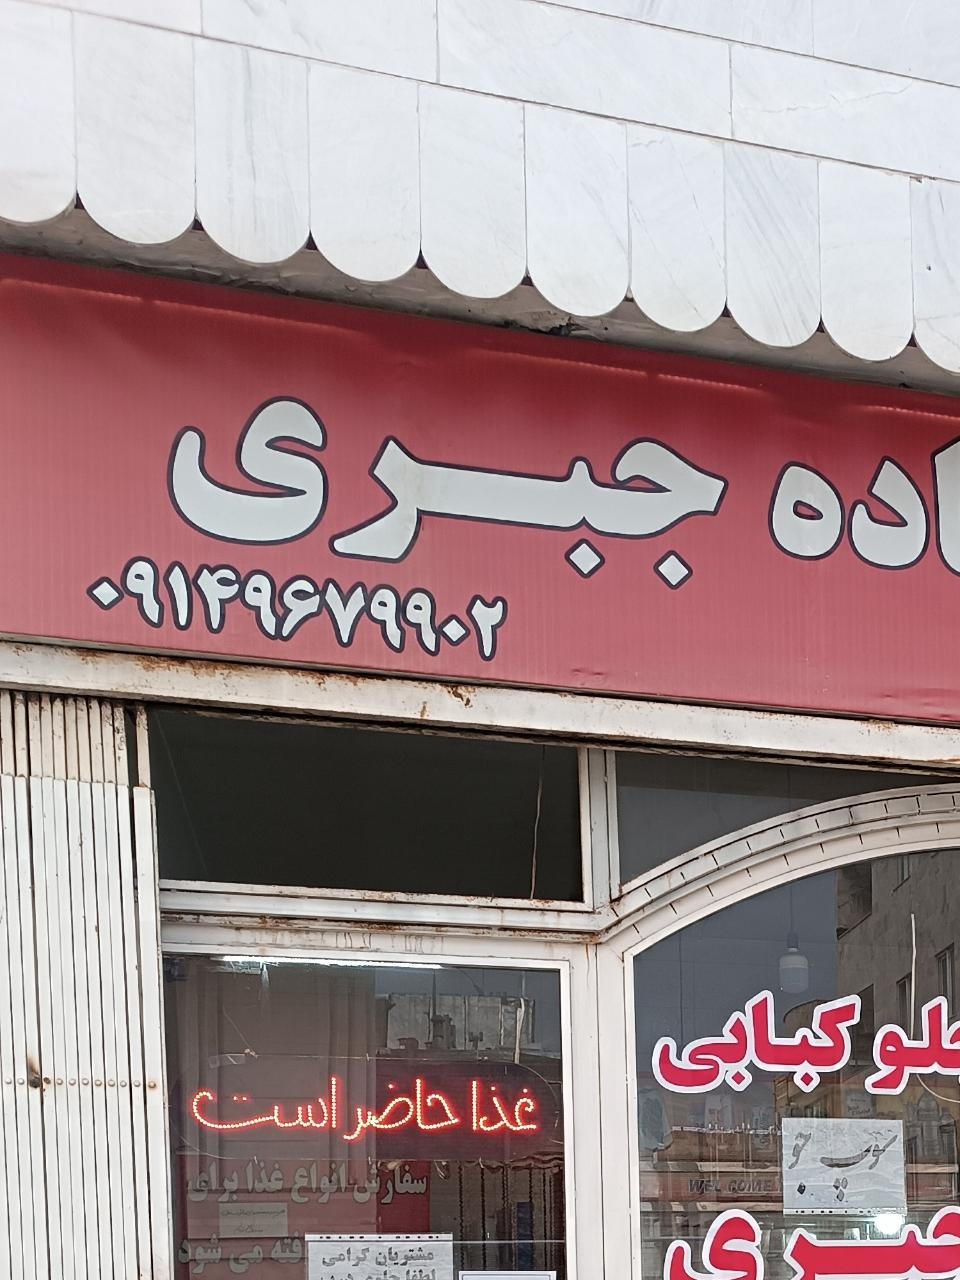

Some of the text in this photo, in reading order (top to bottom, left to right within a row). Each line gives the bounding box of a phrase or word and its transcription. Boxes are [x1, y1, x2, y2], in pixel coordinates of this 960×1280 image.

[169, 396, 728, 589] جبری
[88, 556, 508, 660] ۰۹۱۴۹۶۷۹۹۰۲
[652, 989, 862, 1094] کبابی
[192, 1076, 539, 1141] غذا حاضر است
[245, 1160, 284, 1193] غذا
[291, 1162, 346, 1203] انواع
